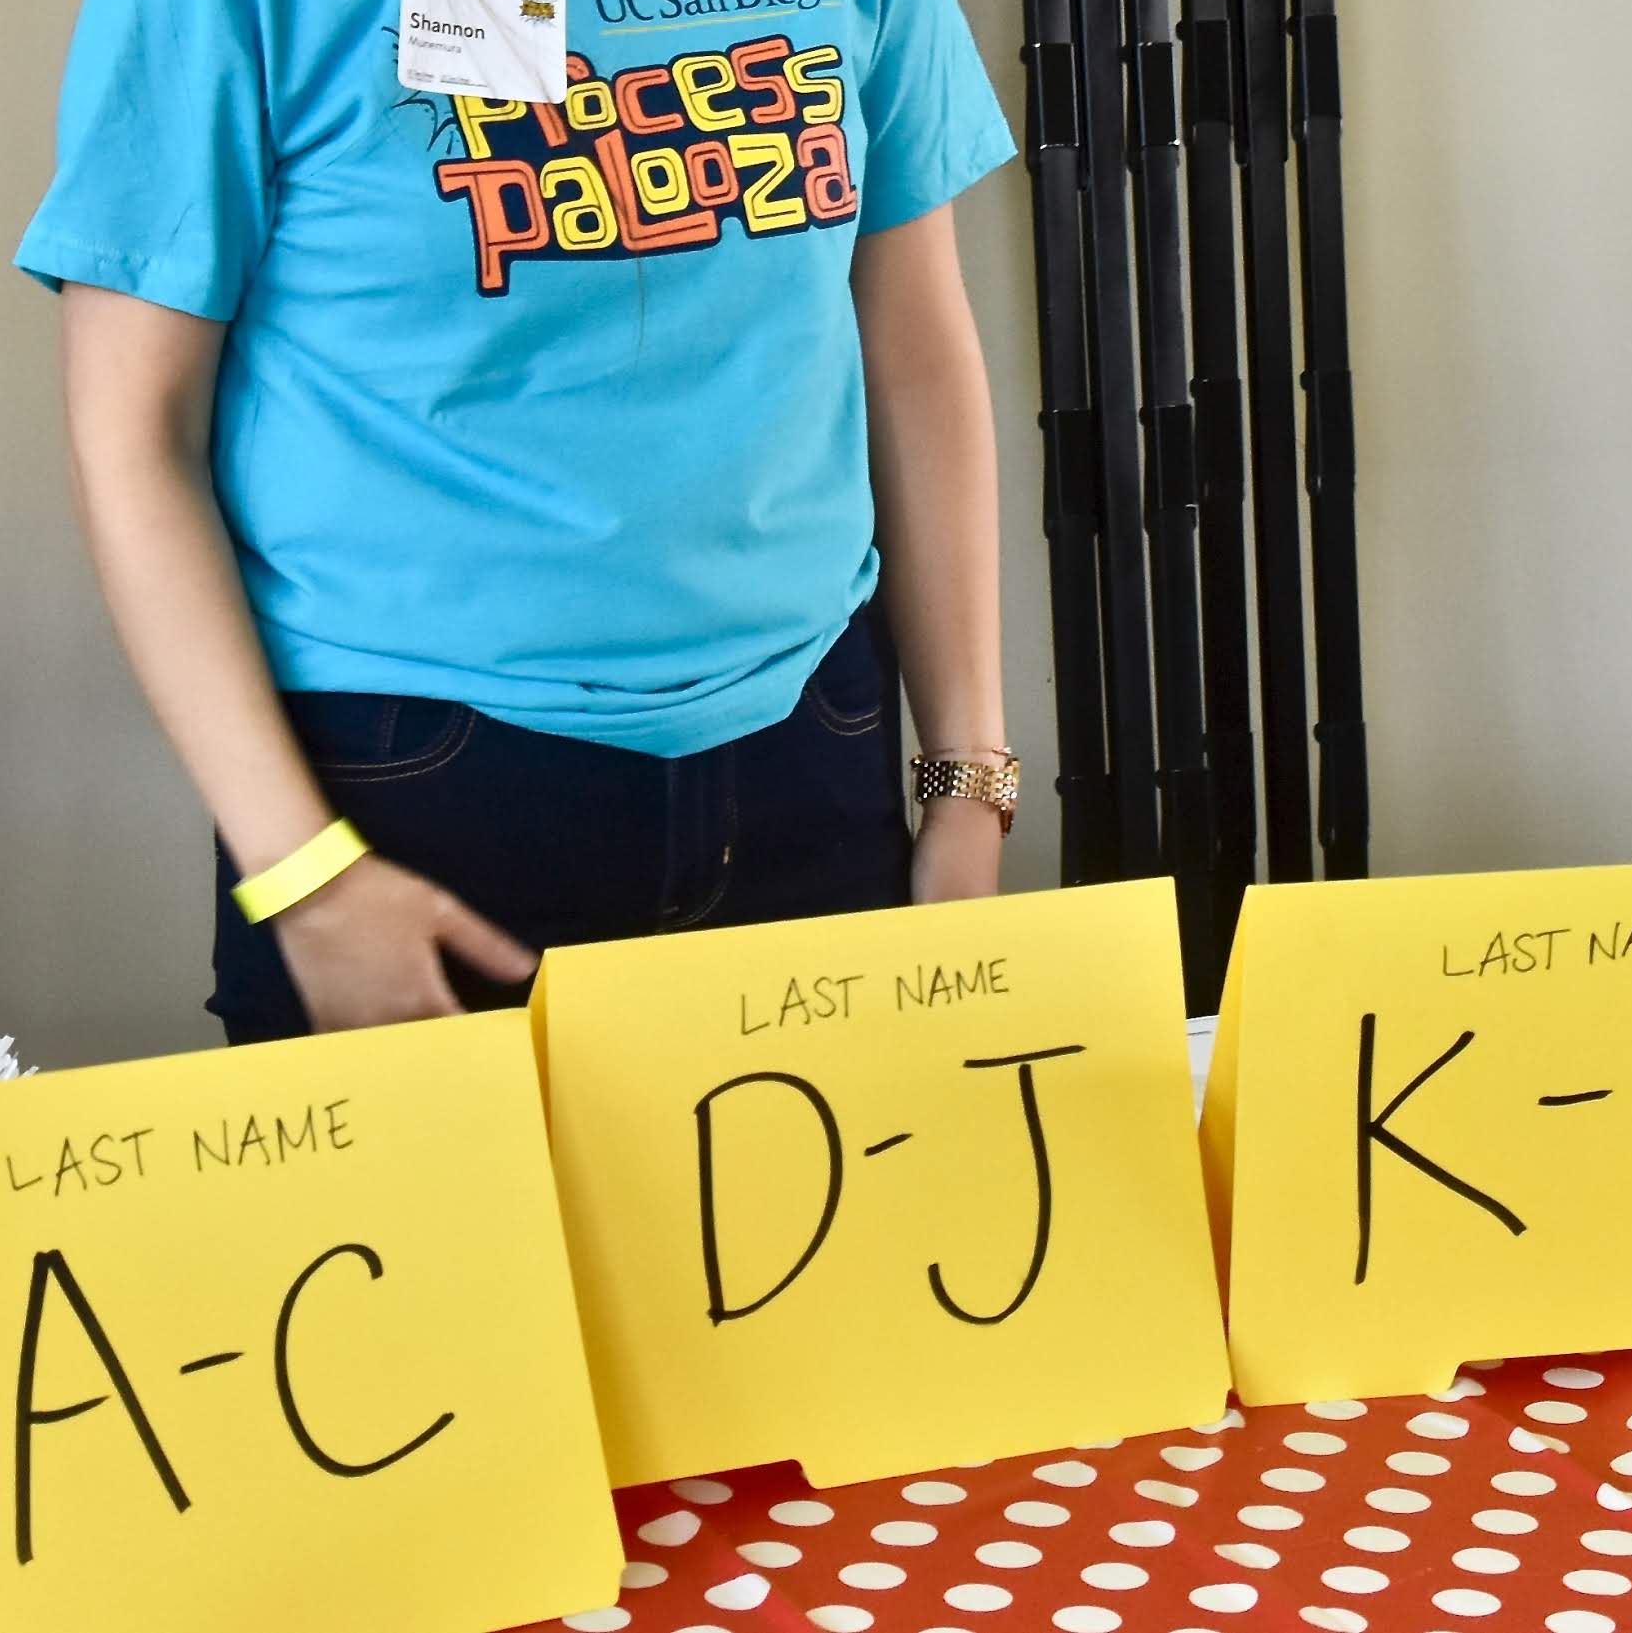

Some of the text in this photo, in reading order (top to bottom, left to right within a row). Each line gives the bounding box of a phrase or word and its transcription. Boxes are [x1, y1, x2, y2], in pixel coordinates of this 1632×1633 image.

[410, 12, 485, 40] Shannon
[1441, 925, 1577, 980] LAST
[738, 957, 1011, 1037] LAST NAME
[5, 1097, 355, 1199] LAST NAME
